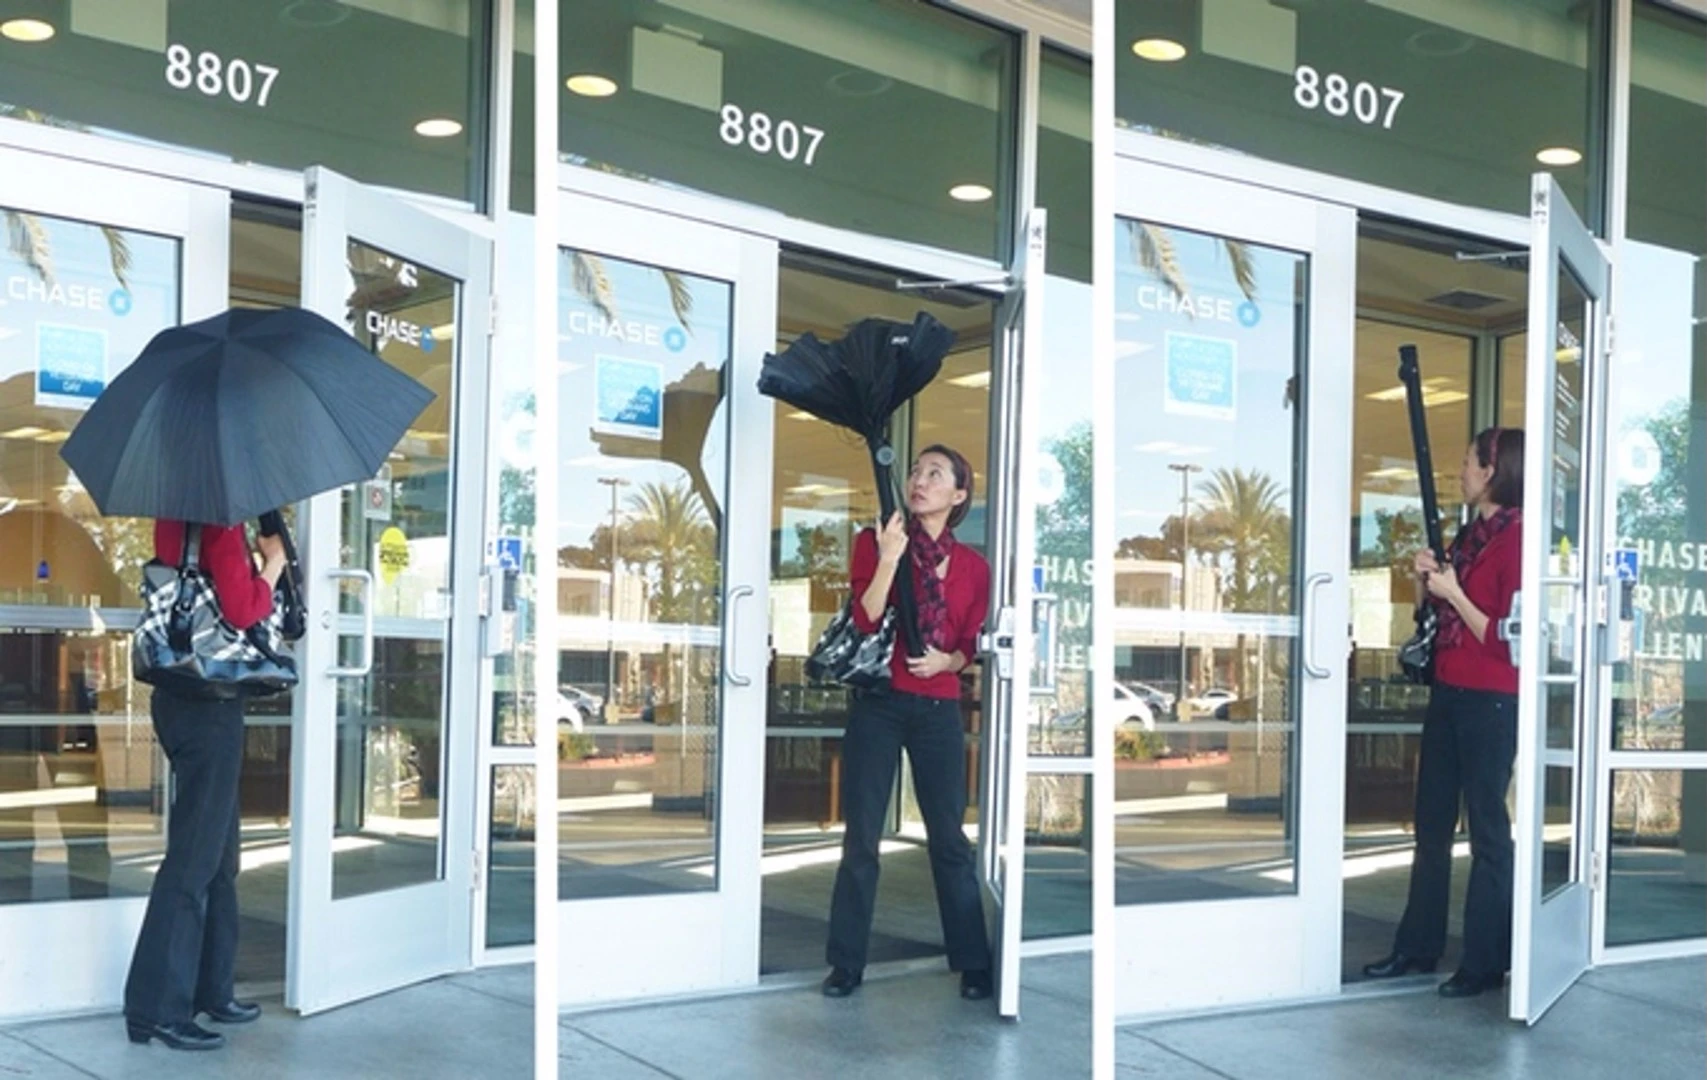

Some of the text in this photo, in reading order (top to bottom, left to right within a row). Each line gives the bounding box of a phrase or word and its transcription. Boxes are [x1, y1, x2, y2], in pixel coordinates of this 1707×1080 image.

[165, 43, 280, 107] 8807
[1294, 64, 1405, 129] 8807
[719, 103, 825, 166] 8807
[8, 275, 104, 310] CHASE
[1137, 285, 1233, 321] CHASE
[365, 309, 420, 348] CHASE
[569, 310, 660, 346] CHASE
